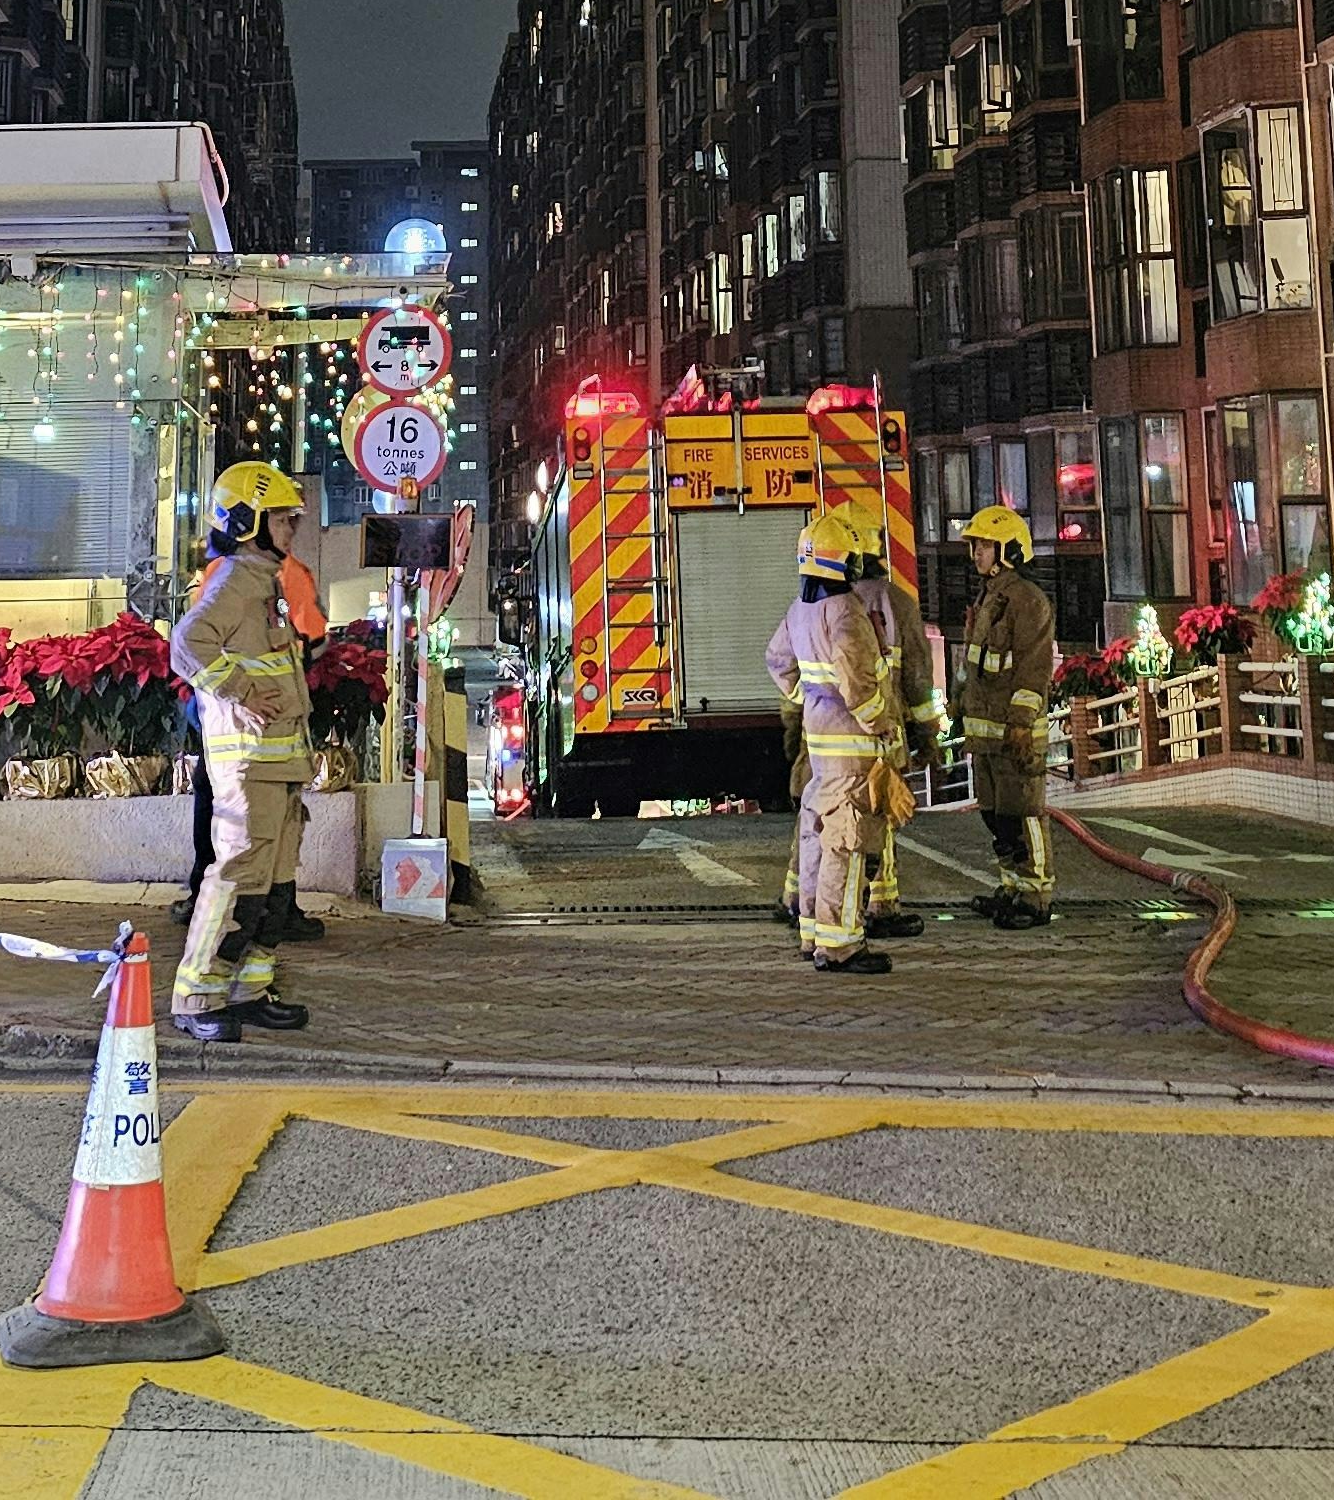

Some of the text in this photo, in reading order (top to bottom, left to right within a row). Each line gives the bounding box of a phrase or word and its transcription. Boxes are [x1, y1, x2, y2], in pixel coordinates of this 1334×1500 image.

[400, 360, 409, 372] 8
[387, 414, 418, 443] 16
[377, 445, 424, 459] tonnes
[684, 445, 809, 462] FIRE SERVICES
[124, 1060, 152, 1095] 警
